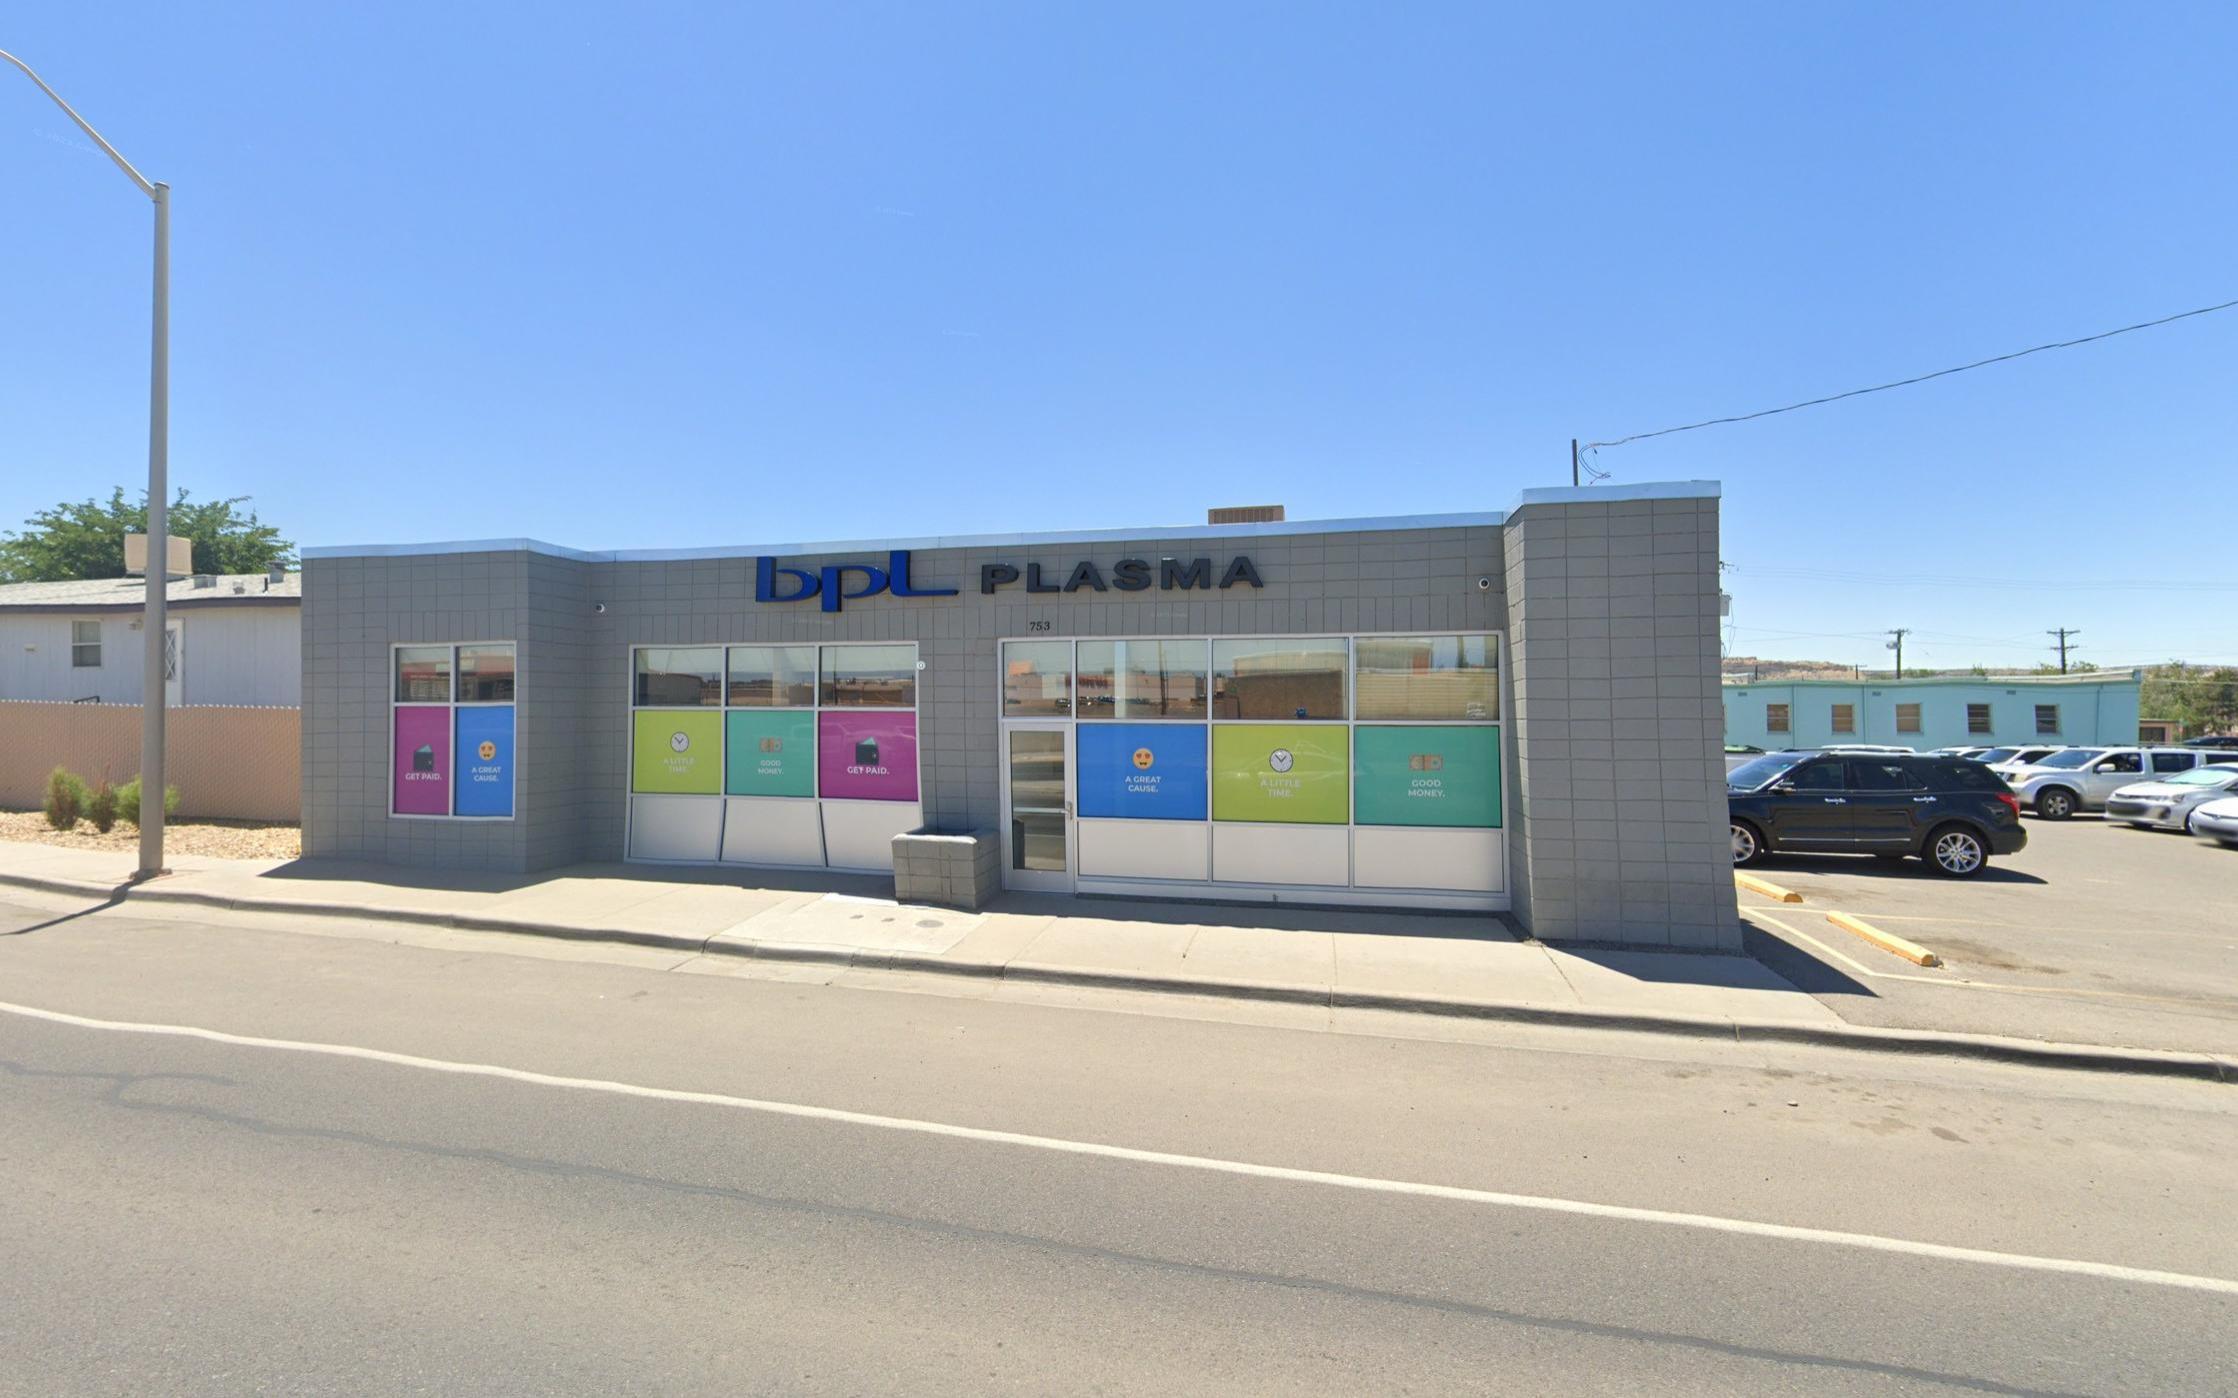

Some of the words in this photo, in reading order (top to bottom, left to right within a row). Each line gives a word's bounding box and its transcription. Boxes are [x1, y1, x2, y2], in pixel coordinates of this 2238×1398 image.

[981, 556, 1264, 595] PLASMA
[1029, 621, 1051, 632] 753
[760, 759, 781, 767] GOOD
[471, 766, 478, 774] A
[479, 766, 502, 774] GREAT
[847, 766, 863, 775] GET
[865, 766, 890, 776] PAID.
[405, 772, 420, 781] GET
[421, 772, 443, 781] PAID.
[473, 774, 499, 783] CAUSE.
[1125, 775, 1132, 783] A
[1133, 775, 1161, 783] GREAT
[1412, 779, 1441, 787] GOOD
[1128, 784, 1159, 792] CAUSE.
[1408, 788, 1446, 798] MONEY.
